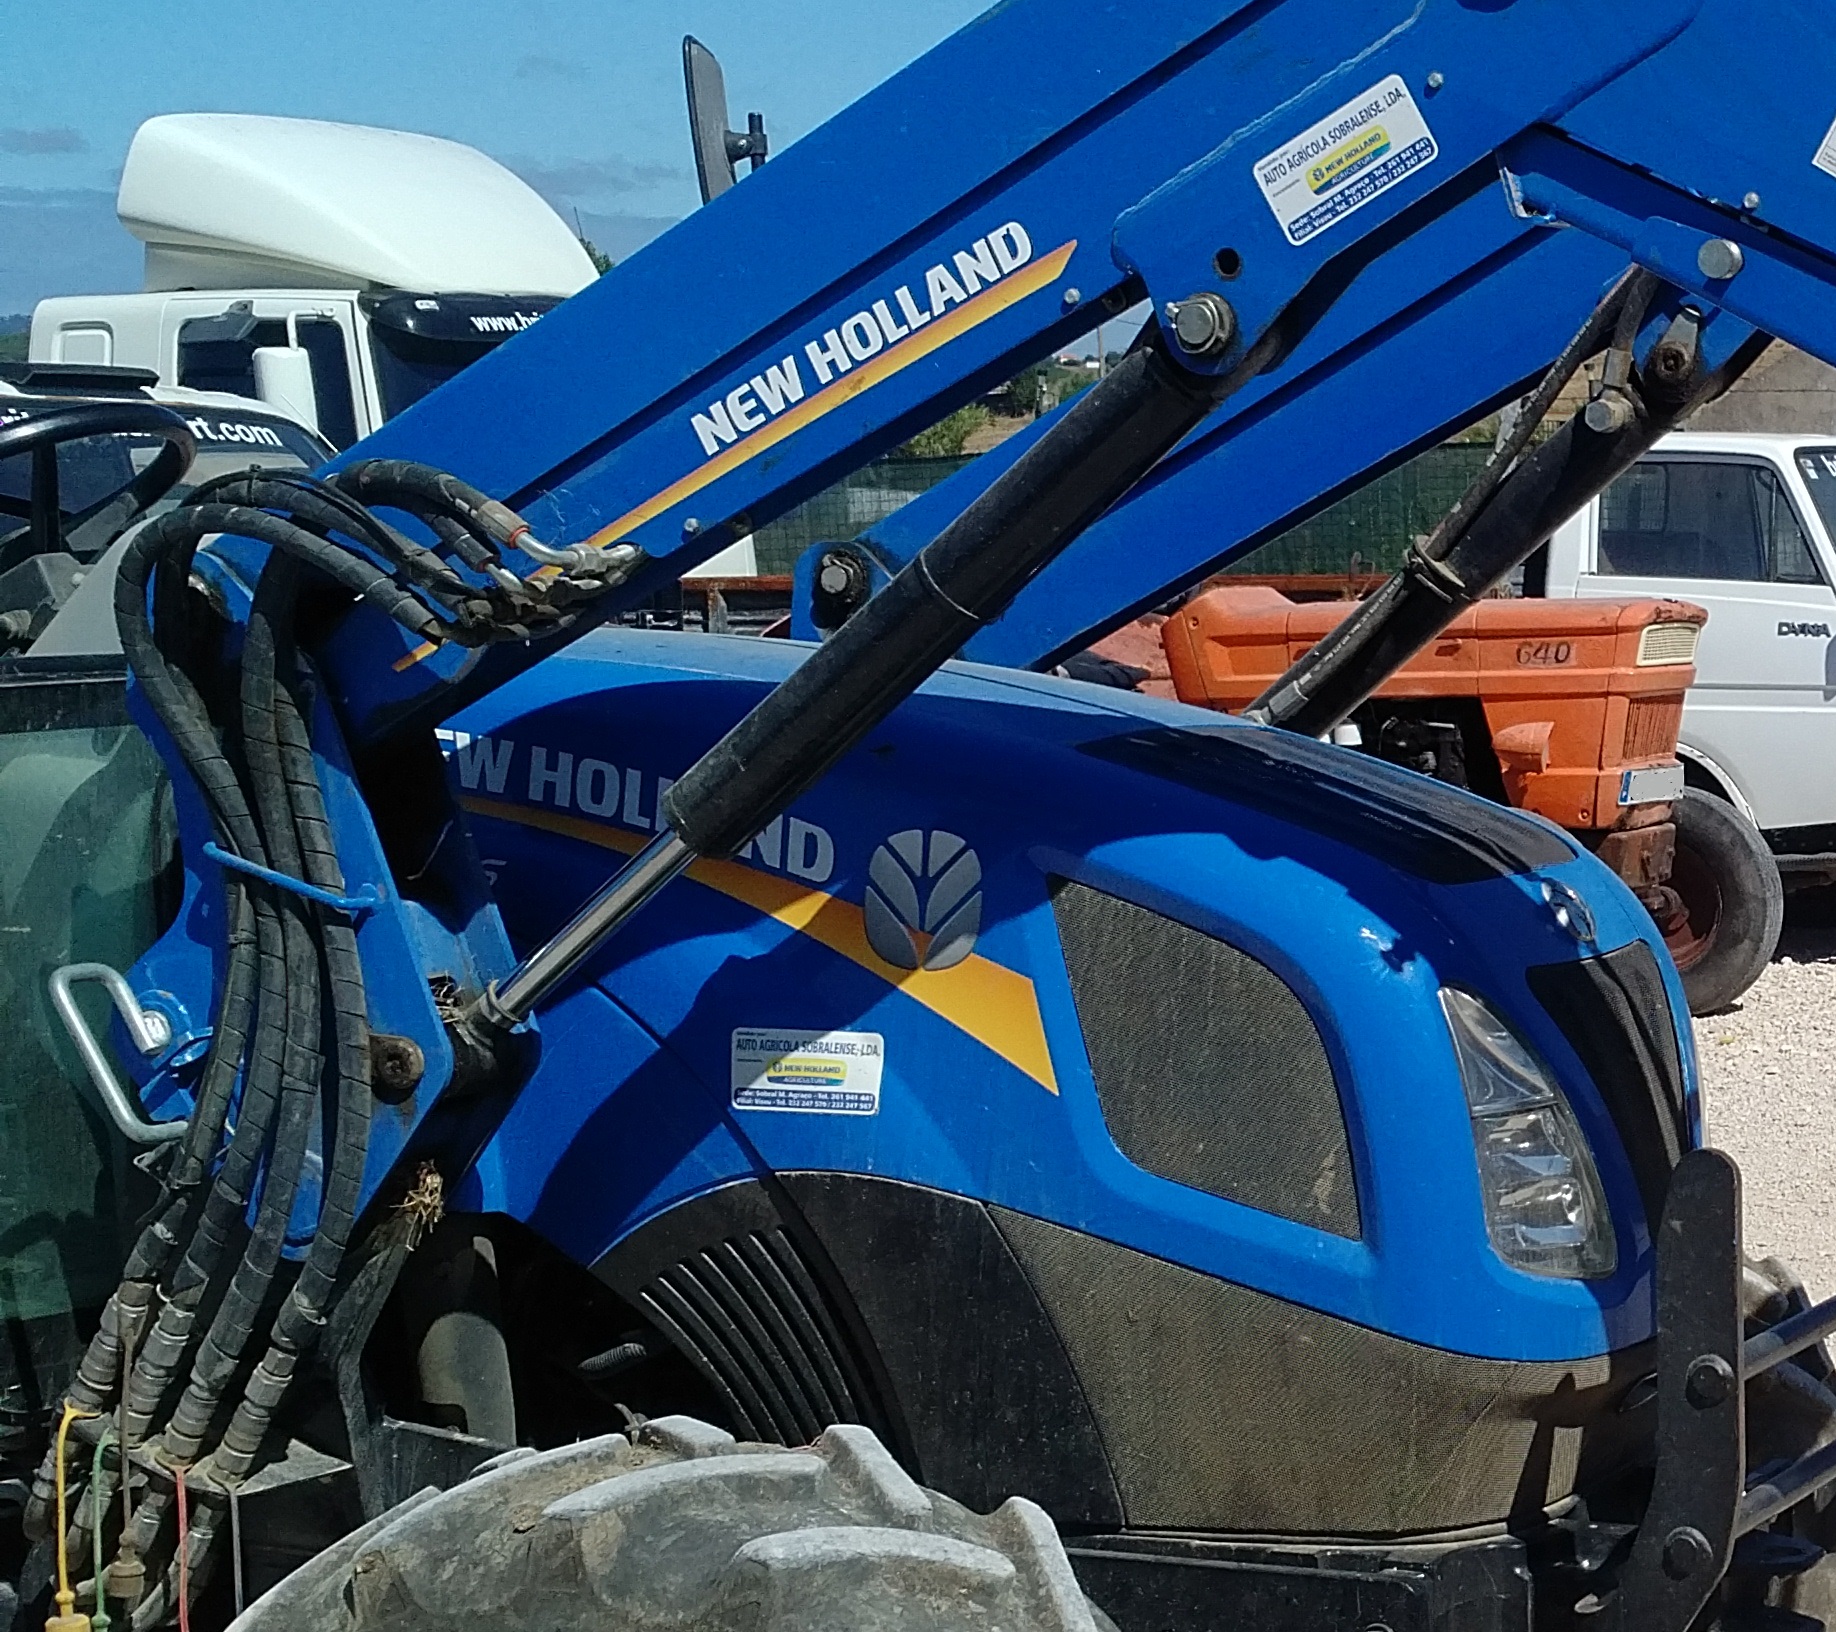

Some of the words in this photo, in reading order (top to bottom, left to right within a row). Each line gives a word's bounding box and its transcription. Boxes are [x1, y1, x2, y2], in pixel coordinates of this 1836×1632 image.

[1263, 163, 1287, 186] AUTO
[1286, 135, 1328, 171] AGRÍCOLA
[1328, 100, 1385, 143] SOBRALENSE,
[1382, 87, 1406, 107] LDA.
[1324, 157, 1343, 173] NEW
[1344, 132, 1380, 161] HOLLAND
[690, 356, 804, 456] NEW
[804, 221, 1033, 385] HOLLAND
[1777, 622, 1831, 638] DYNA
[1516, 640, 1571, 665] 640
[736, 1038, 757, 1052] AUTO
[860, 1042, 881, 1057] LDA.
[783, 1064, 802, 1072] NEW
[803, 1064, 841, 1073] HOLLAND
